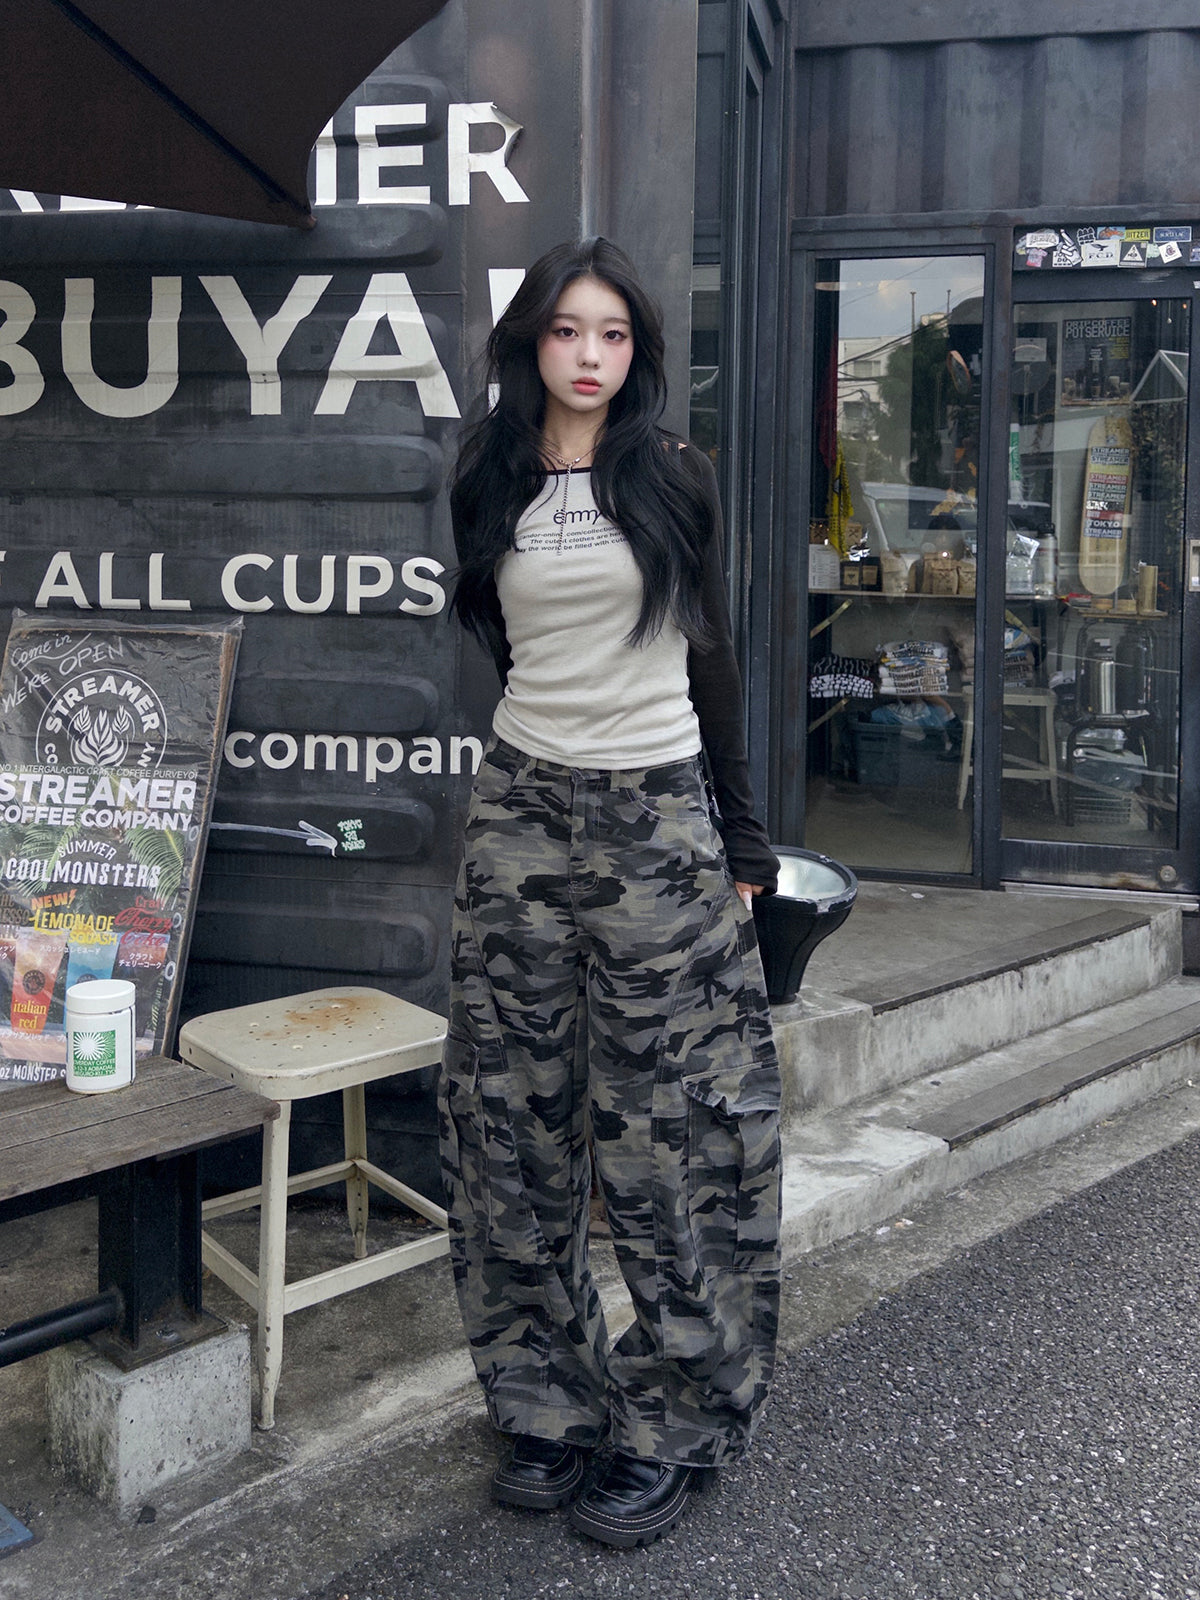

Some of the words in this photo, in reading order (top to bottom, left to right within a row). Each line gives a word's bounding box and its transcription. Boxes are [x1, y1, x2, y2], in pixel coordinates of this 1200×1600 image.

[1085, 325, 1130, 337] SERVICE
[35, 551, 192, 611] ALL
[221, 553, 447, 616] CUPS
[10, 641, 52, 669] Come
[55, 634, 72, 649] in
[2, 672, 51, 713] WE'RE
[58, 636, 125, 676] OPEN
[45, 675, 161, 734] STREAMER
[223, 731, 484, 783] compan
[20, 764, 85, 776] INTERGALACTIC
[116, 767, 151, 778] COFFEE
[0, 772, 197, 810] STREAMER
[80, 808, 192, 832] COMPANY
[57, 839, 117, 861] SUMMER
[31, 888, 77, 911] NEW!
[29, 908, 116, 936] LEMONADE
[68, 931, 118, 947] SQUASH
[118, 960, 163, 970] チェリーコーク
[129, 952, 154, 961] クラフト
[13, 999, 48, 1015] italian
[18, 1015, 38, 1029] red
[12, 1063, 58, 1082] MONSTER
